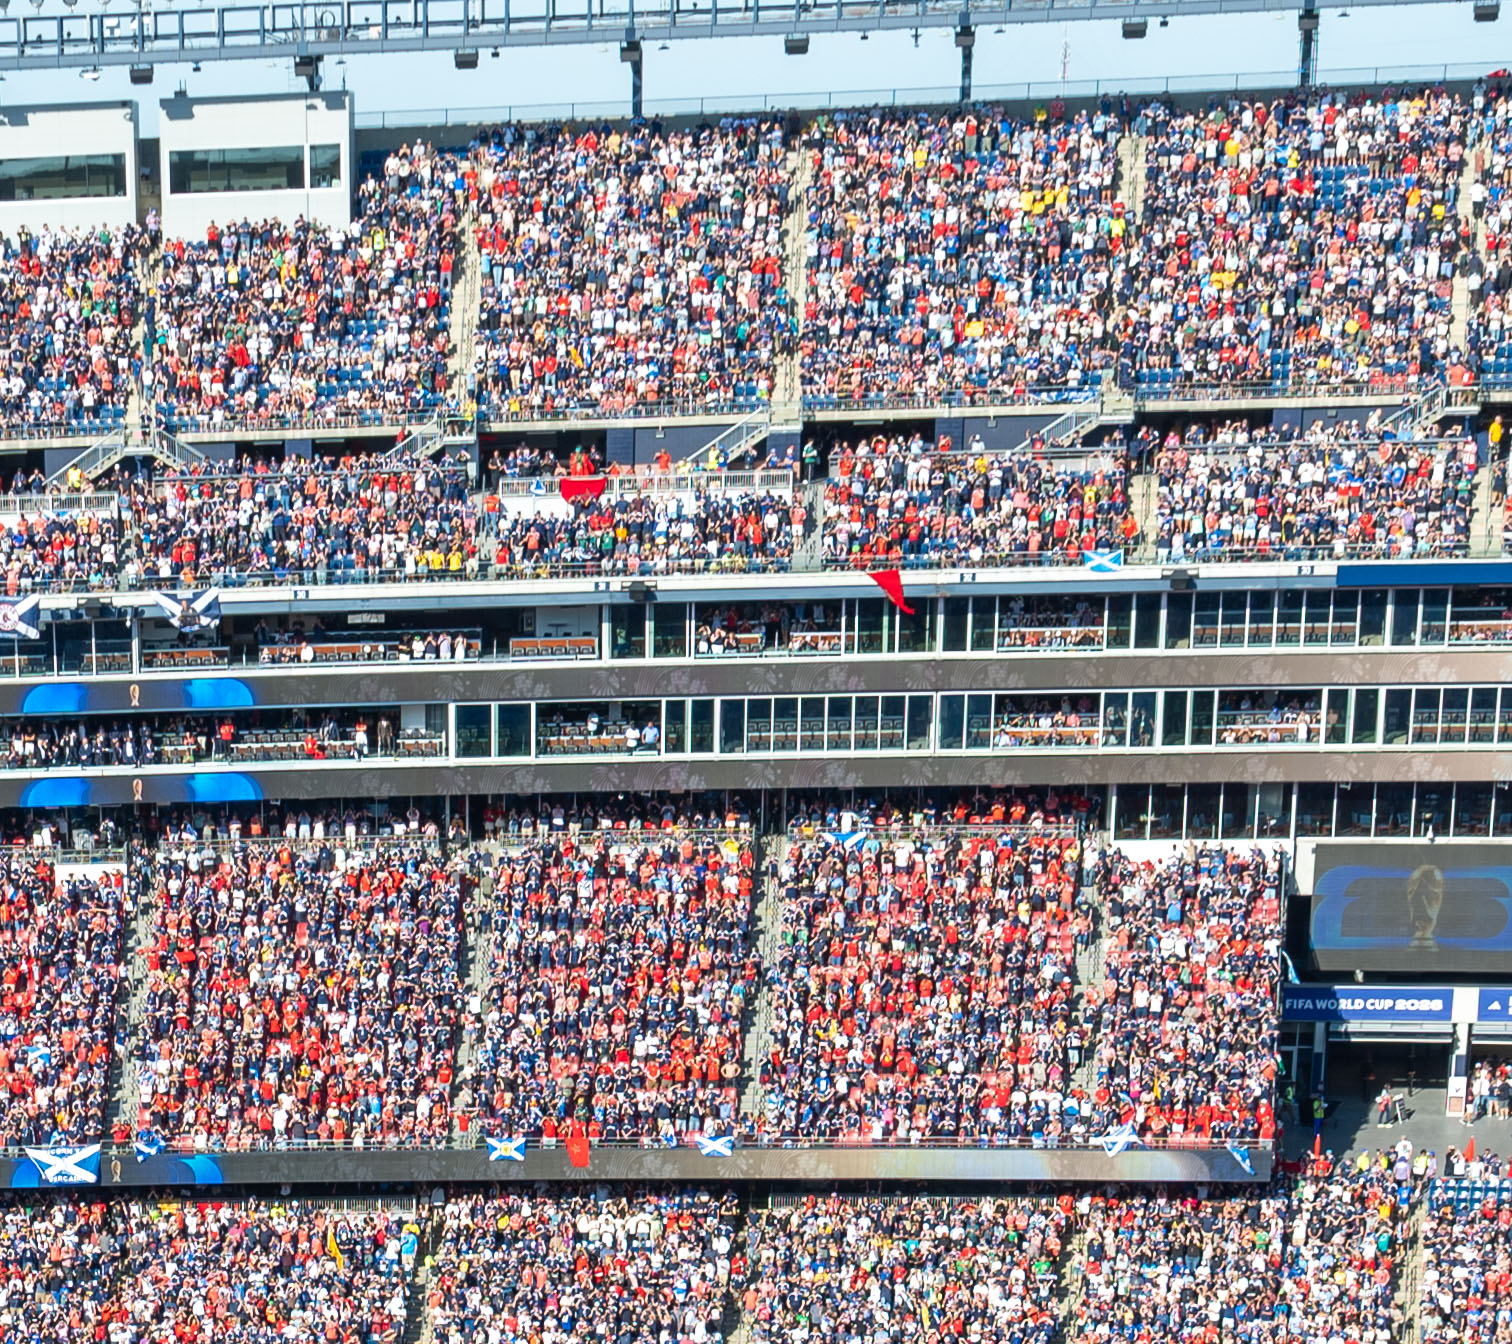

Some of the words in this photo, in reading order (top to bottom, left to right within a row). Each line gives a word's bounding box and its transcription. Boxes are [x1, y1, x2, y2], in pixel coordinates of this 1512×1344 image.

[1285, 998, 1313, 1010] FIFA
[1316, 998, 1367, 1010] WORLD
[1369, 998, 1394, 1011] CUP
[1395, 999, 1443, 1011] 2026
